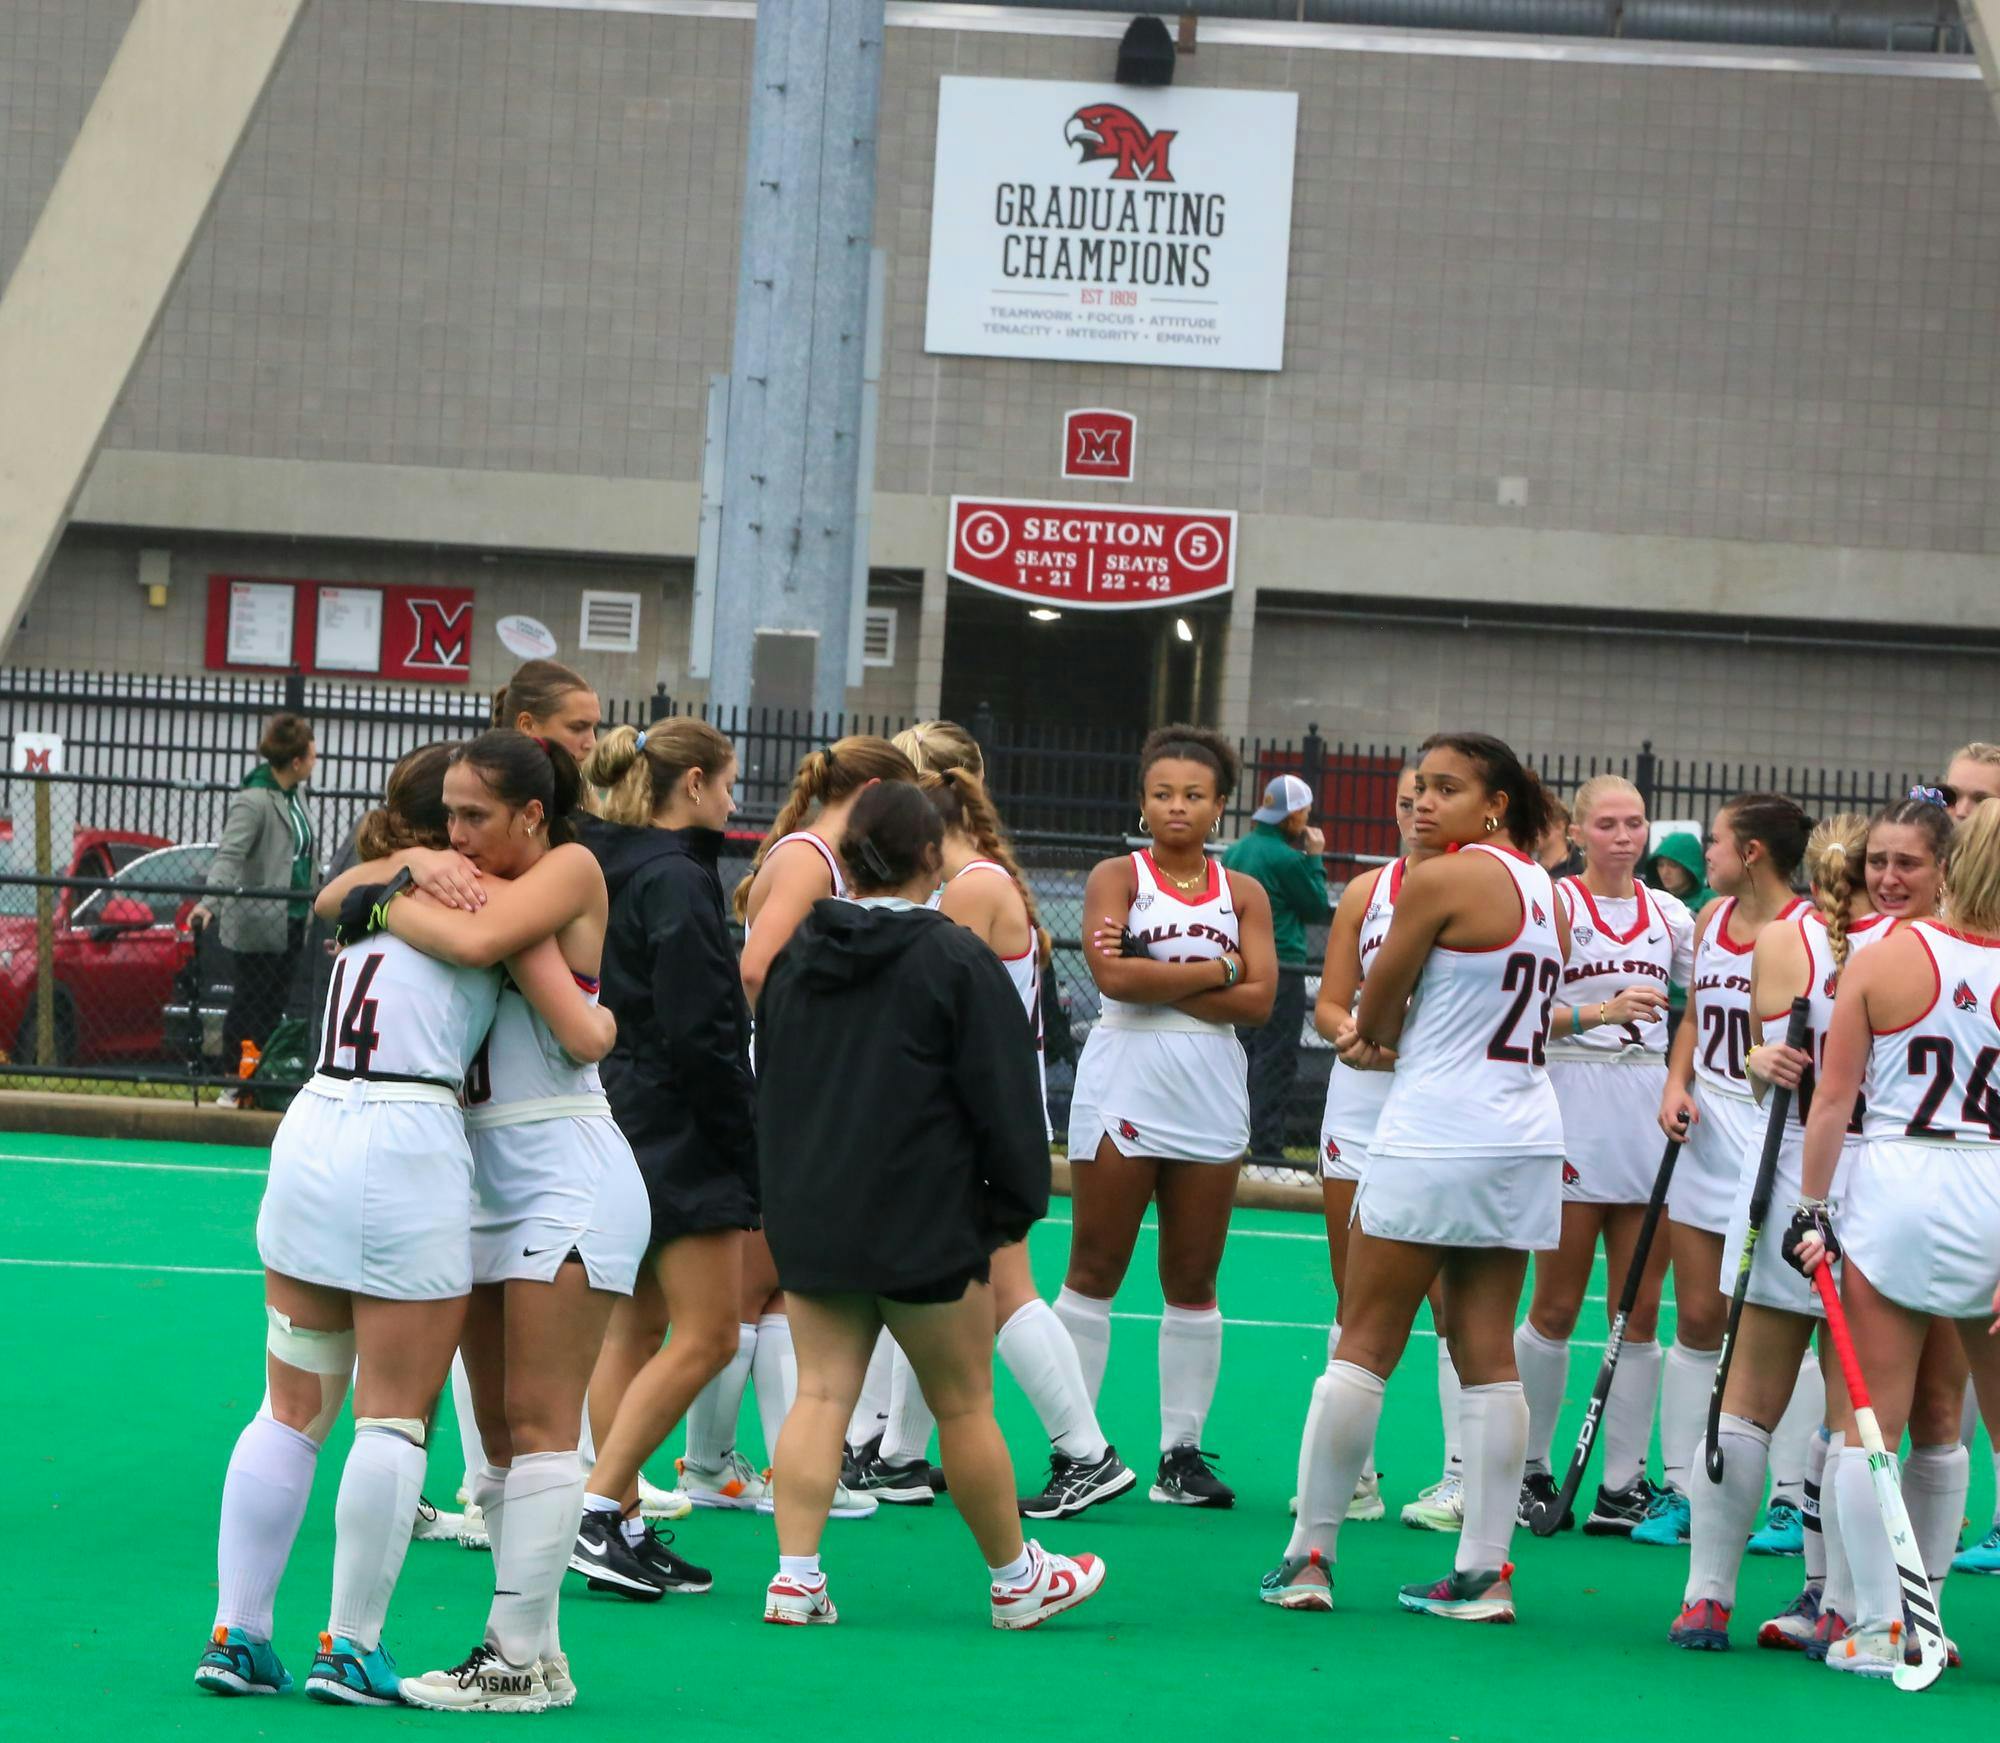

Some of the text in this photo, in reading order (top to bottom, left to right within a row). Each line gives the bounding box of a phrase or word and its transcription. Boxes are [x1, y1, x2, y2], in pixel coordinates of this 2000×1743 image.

[995, 182, 1226, 238] GRADUATING
[1002, 234, 1211, 288] CHAMPIONS
[1081, 288, 1137, 307] EST 1809
[990, 306, 1217, 329] TEAMWORK FOCUS ATTITUDE
[983, 322, 1221, 346] TENACITY INTEGRITY EMPATHY
[1075, 427, 1122, 466] M
[975, 522, 995, 547] 6
[1022, 517, 1165, 547] SECTION
[1014, 549, 1077, 569] SEATS
[1189, 535, 1208, 558] 5
[1105, 554, 1169, 573] SEATS
[403, 599, 473, 670] M
[23, 747, 52, 773] M
[1564, 960, 1619, 985] BALL
[322, 953, 386, 1072] 14
[1487, 951, 1560, 1066] 23
[1703, 1004, 1751, 1080] 20
[1576, 1397, 1601, 1467] JDH
[476, 1675, 532, 1693] OSAKA
